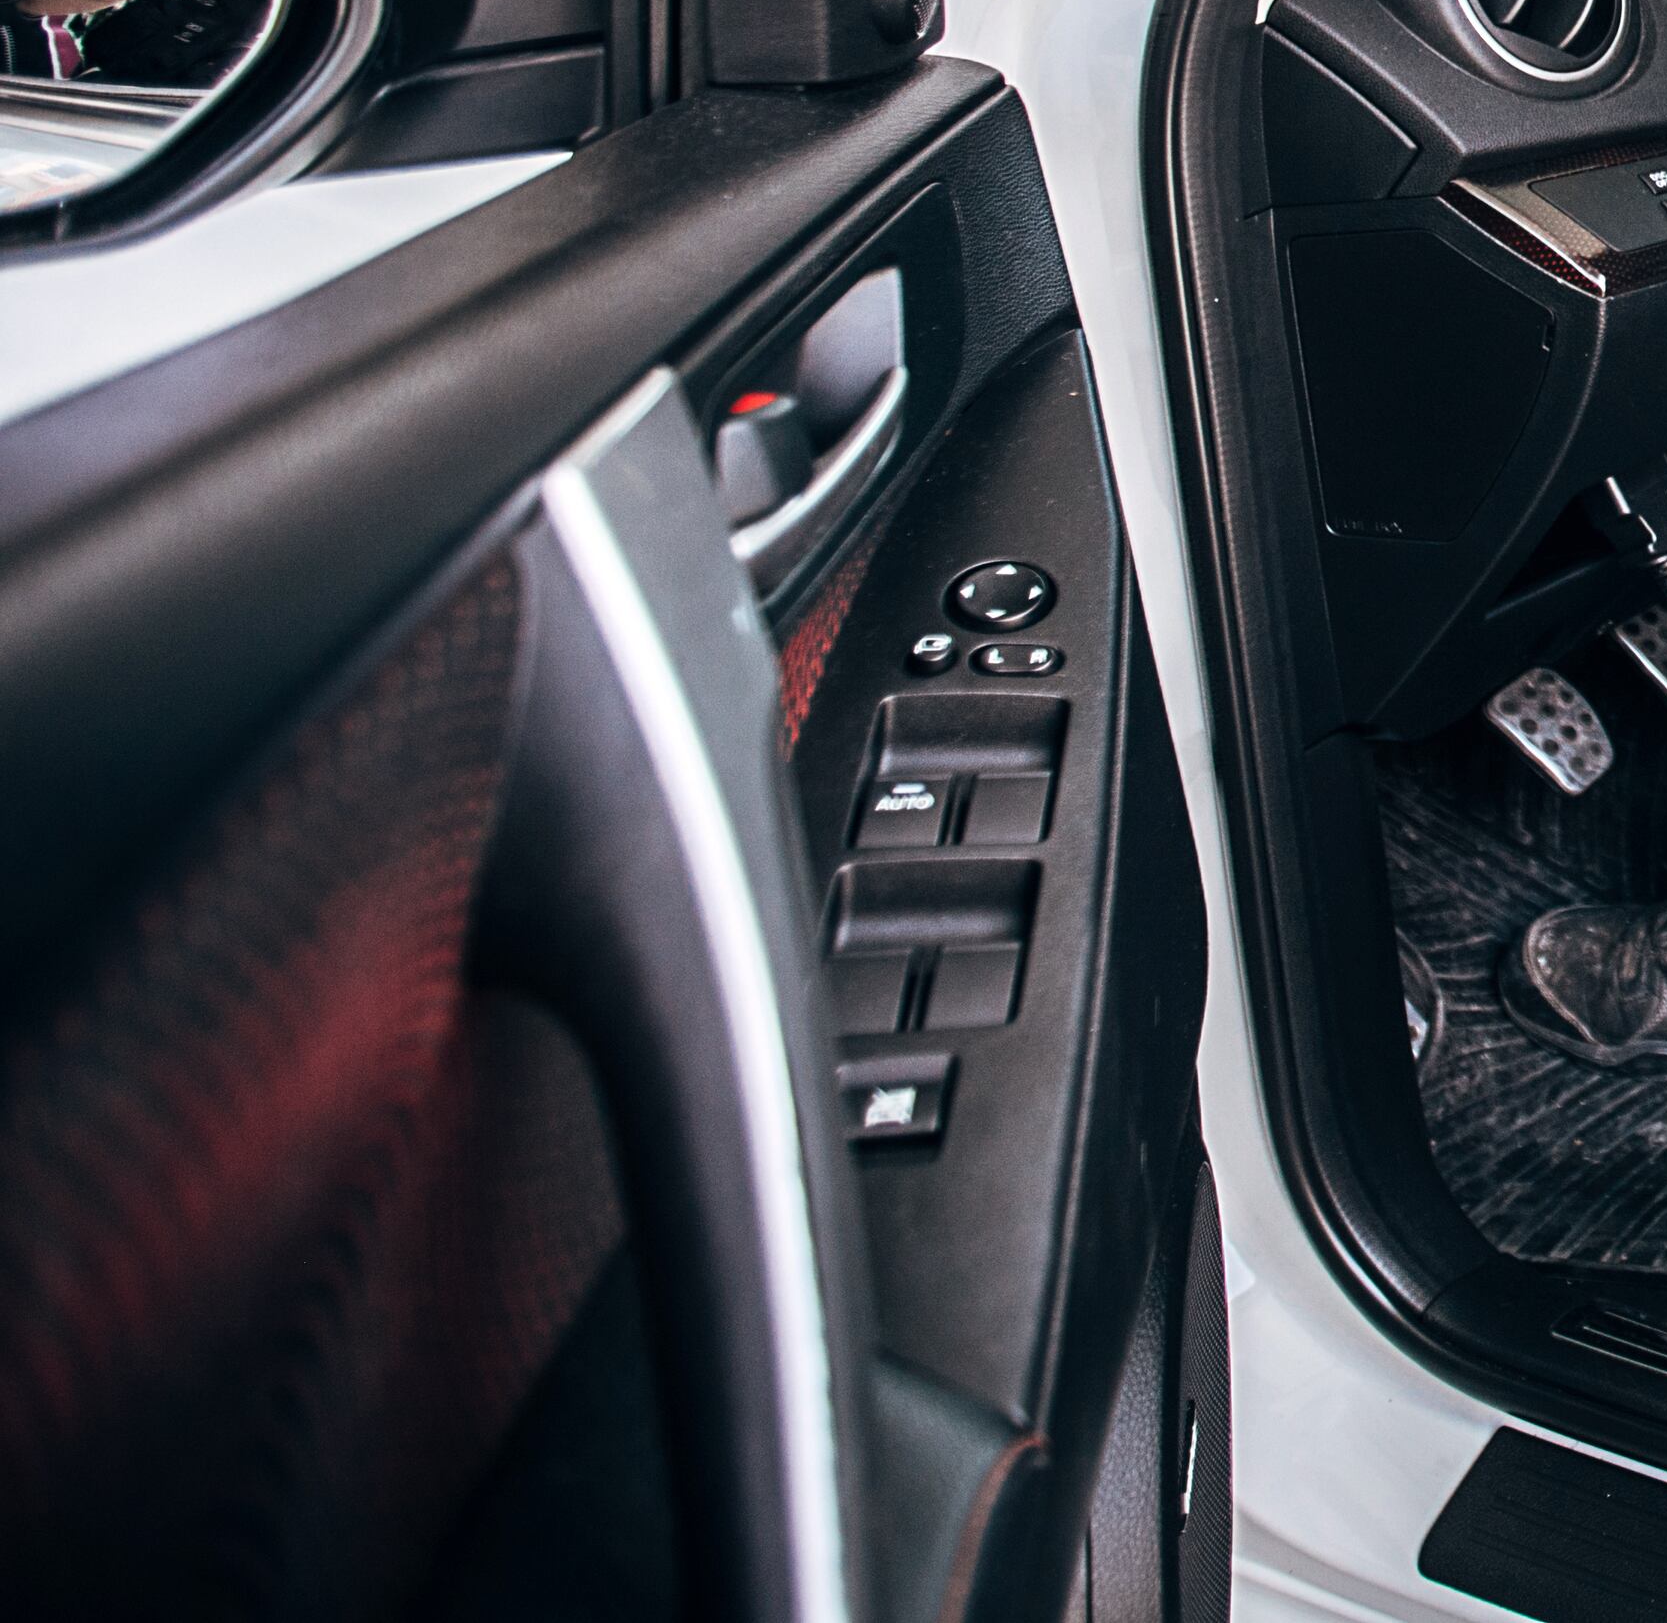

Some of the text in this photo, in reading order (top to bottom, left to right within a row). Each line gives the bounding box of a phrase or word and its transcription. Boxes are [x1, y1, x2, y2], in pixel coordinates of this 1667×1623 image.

[988, 648, 1048, 664] L R
[874, 792, 935, 811] AUTO
